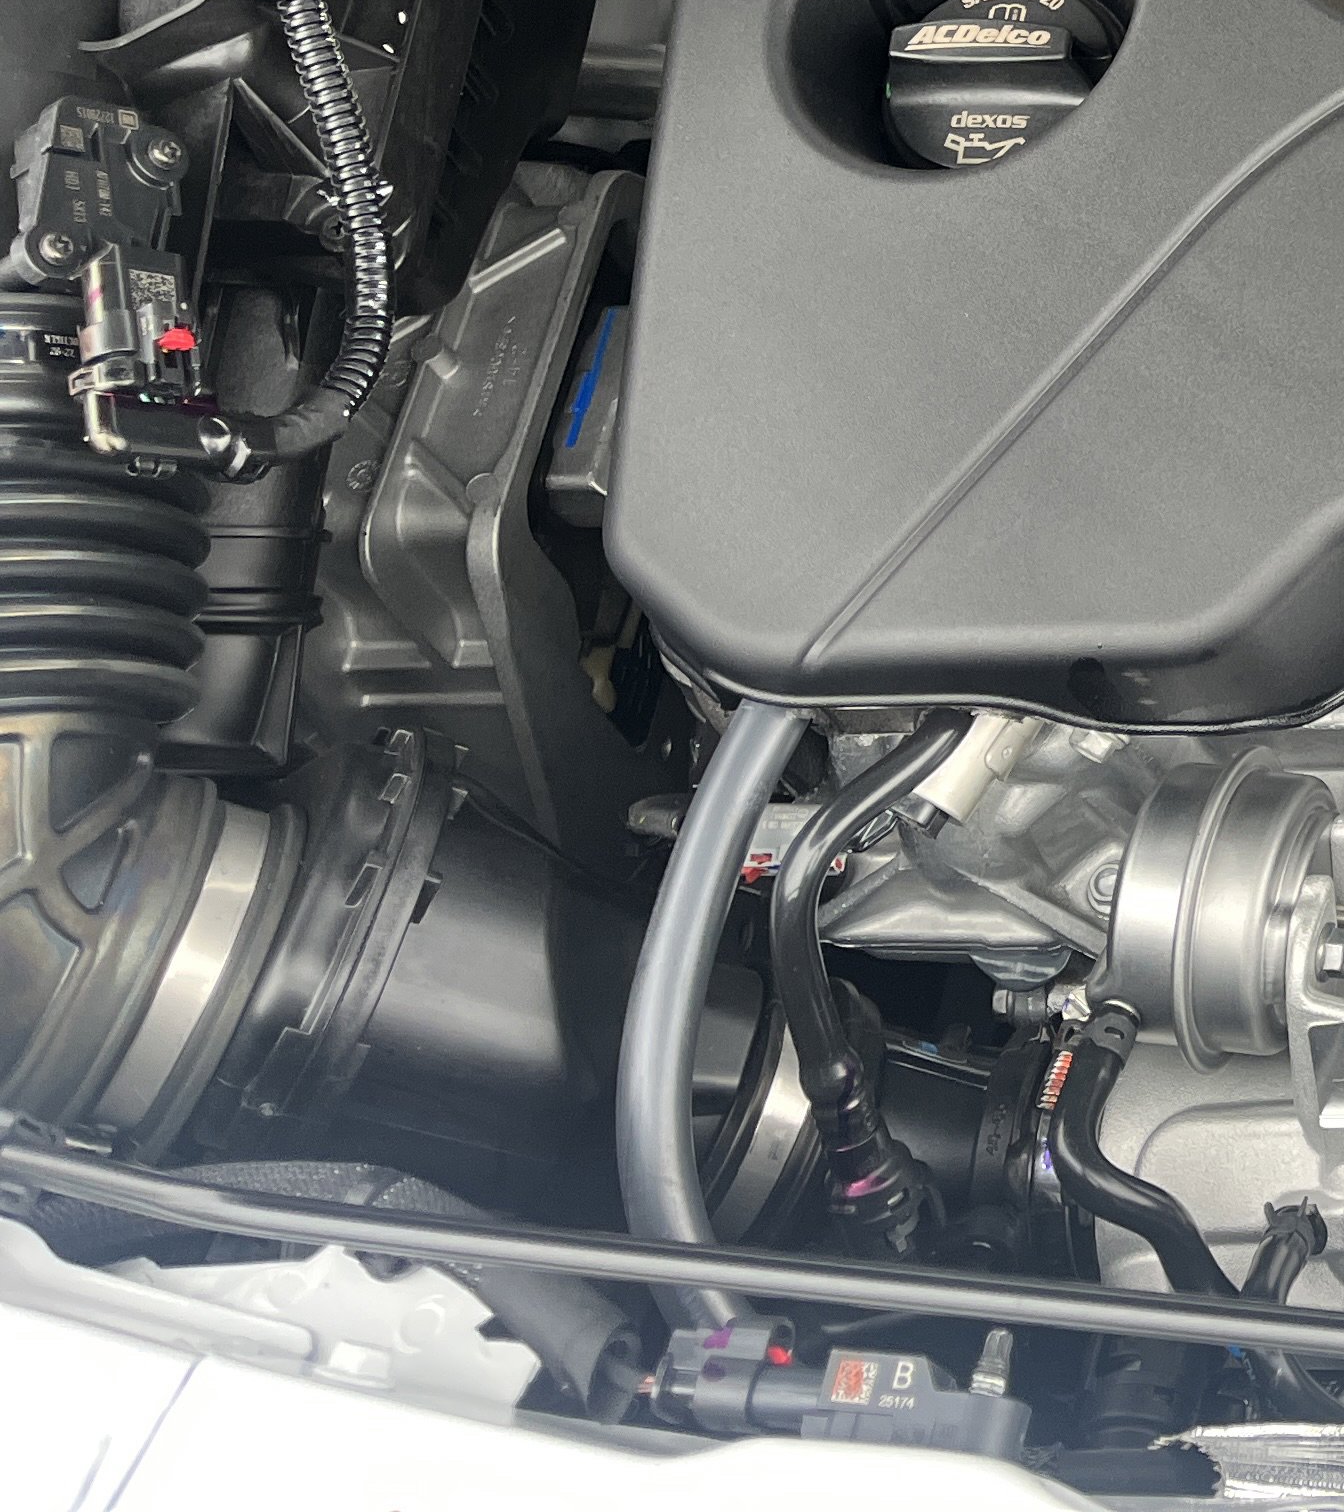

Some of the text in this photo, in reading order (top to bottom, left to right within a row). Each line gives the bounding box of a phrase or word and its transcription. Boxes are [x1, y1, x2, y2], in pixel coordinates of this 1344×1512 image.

[907, 24, 1051, 46] ACDelco
[951, 110, 1031, 129] dexos
[892, 1360, 914, 1391] B
